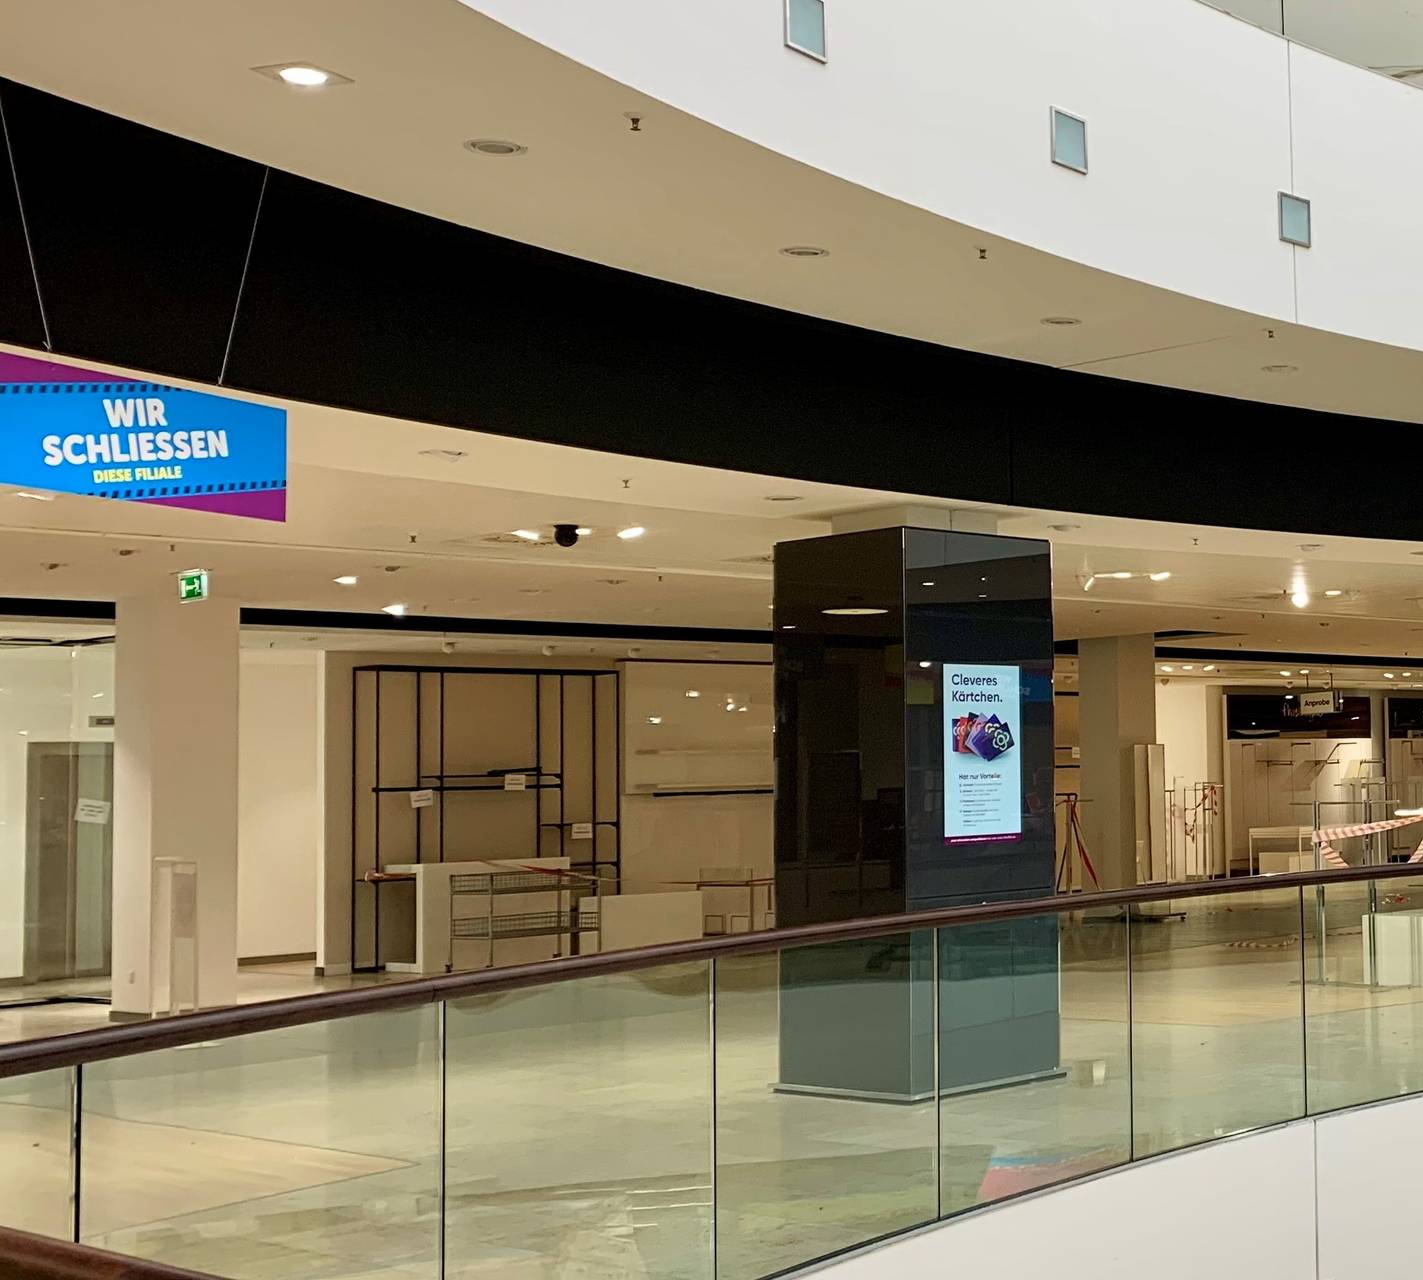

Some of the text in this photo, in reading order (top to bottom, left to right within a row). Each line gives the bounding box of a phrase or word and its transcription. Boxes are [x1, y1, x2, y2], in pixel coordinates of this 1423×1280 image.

[103, 398, 168, 428] WIR
[42, 430, 229, 466] SCHLIESSEN
[93, 466, 183, 484] DIESE FILIALE
[951, 673, 998, 686] Cleveres
[952, 690, 1003, 703] Kärtchen.
[1304, 699, 1330, 707] Anprobe
